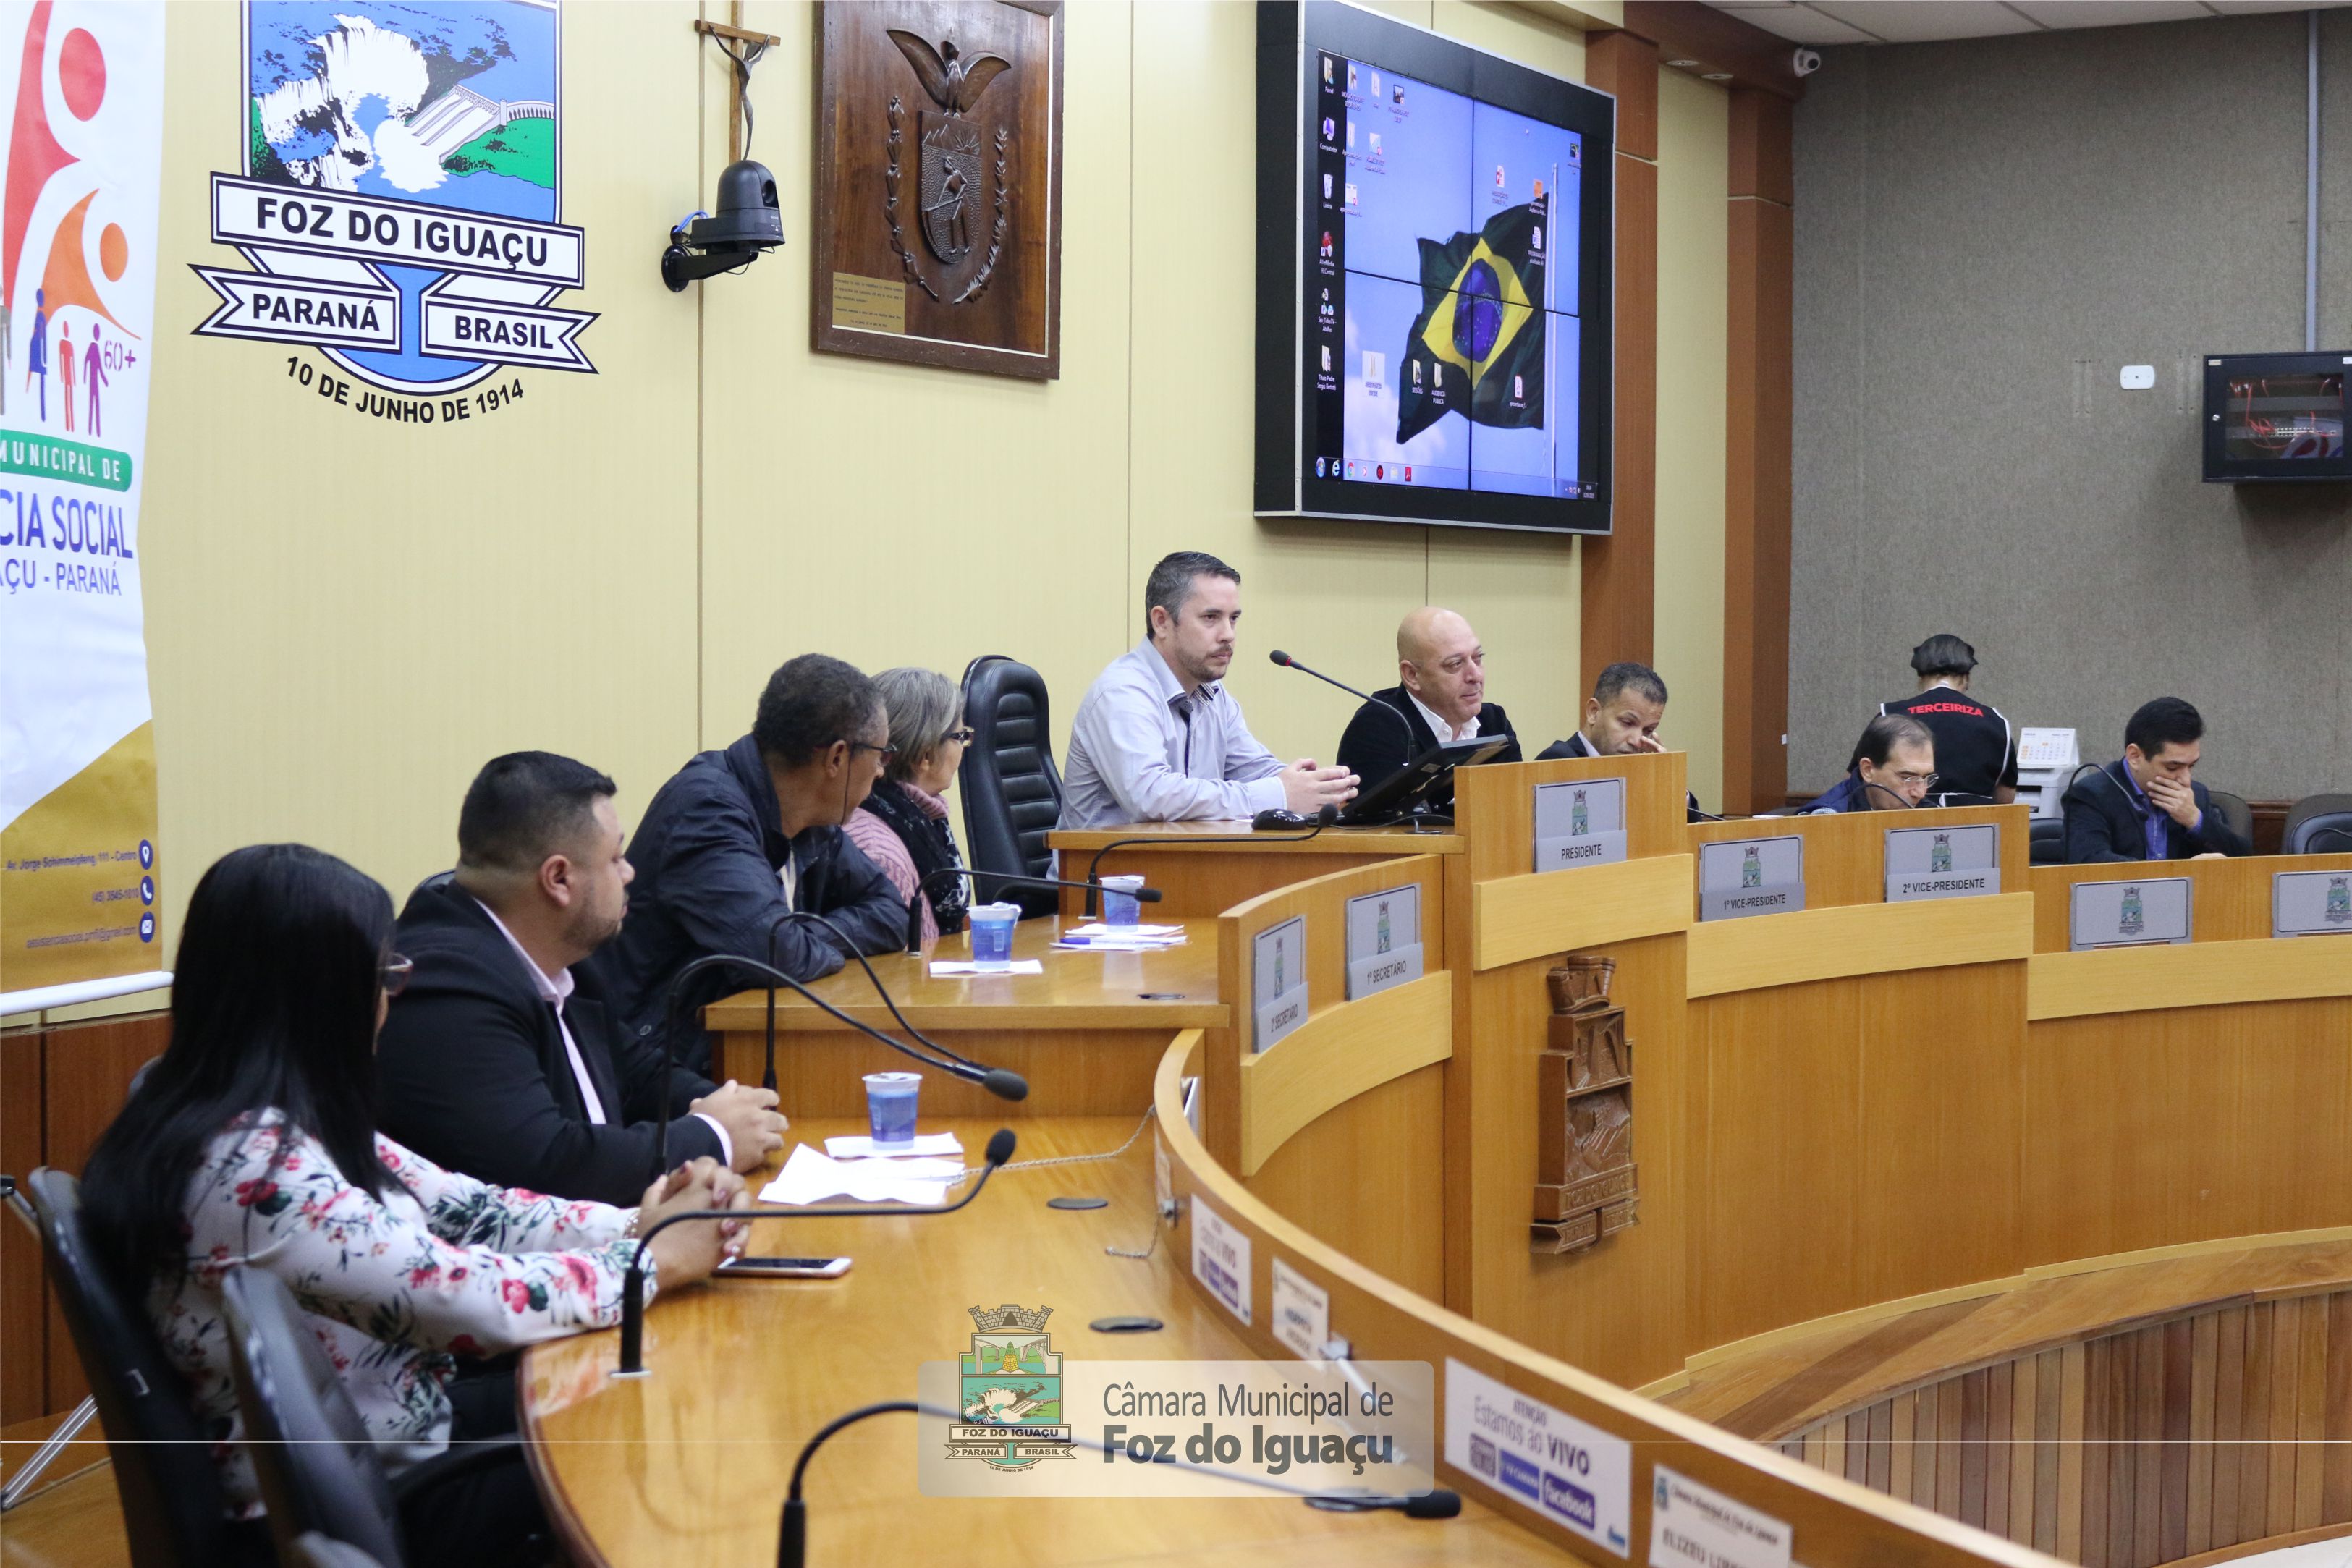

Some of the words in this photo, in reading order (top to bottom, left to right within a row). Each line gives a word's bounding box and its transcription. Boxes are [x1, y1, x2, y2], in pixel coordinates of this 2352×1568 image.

[257, 197, 334, 238] FOZ
[348, 209, 399, 245] DO
[414, 219, 548, 271] IGUAÇU
[253, 294, 380, 332] PARANÁ
[454, 315, 554, 349] BRASIL
[103, 339, 136, 371] 60+
[287, 356, 313, 386] 10
[318, 373, 350, 406] DE
[356, 391, 435, 424] JUNHO
[441, 397, 470, 423] DE
[475, 378, 524, 414] 1914
[102, 457, 121, 482] DE
[52, 496, 134, 559] SOCIAL
[0, 558, 36, 595] ÇU
[56, 561, 122, 596] PARANÁ
[1907, 702, 1984, 718] TERCEIRIZA
[1561, 844, 1602, 860] PRESIDENTE
[1723, 900, 1730, 910] 1º
[1730, 894, 1786, 910] VICE-PRESIDENTE
[1903, 882, 1911, 894] 2º
[1913, 878, 1985, 892] VICE-PRESIDENTE
[1373, 960, 1406, 983] SECRETÁRIO
[1474, 1395, 1523, 1446] Estamos
[1528, 1428, 1542, 1455] ao
[1547, 1433, 1590, 1476] VIVO
